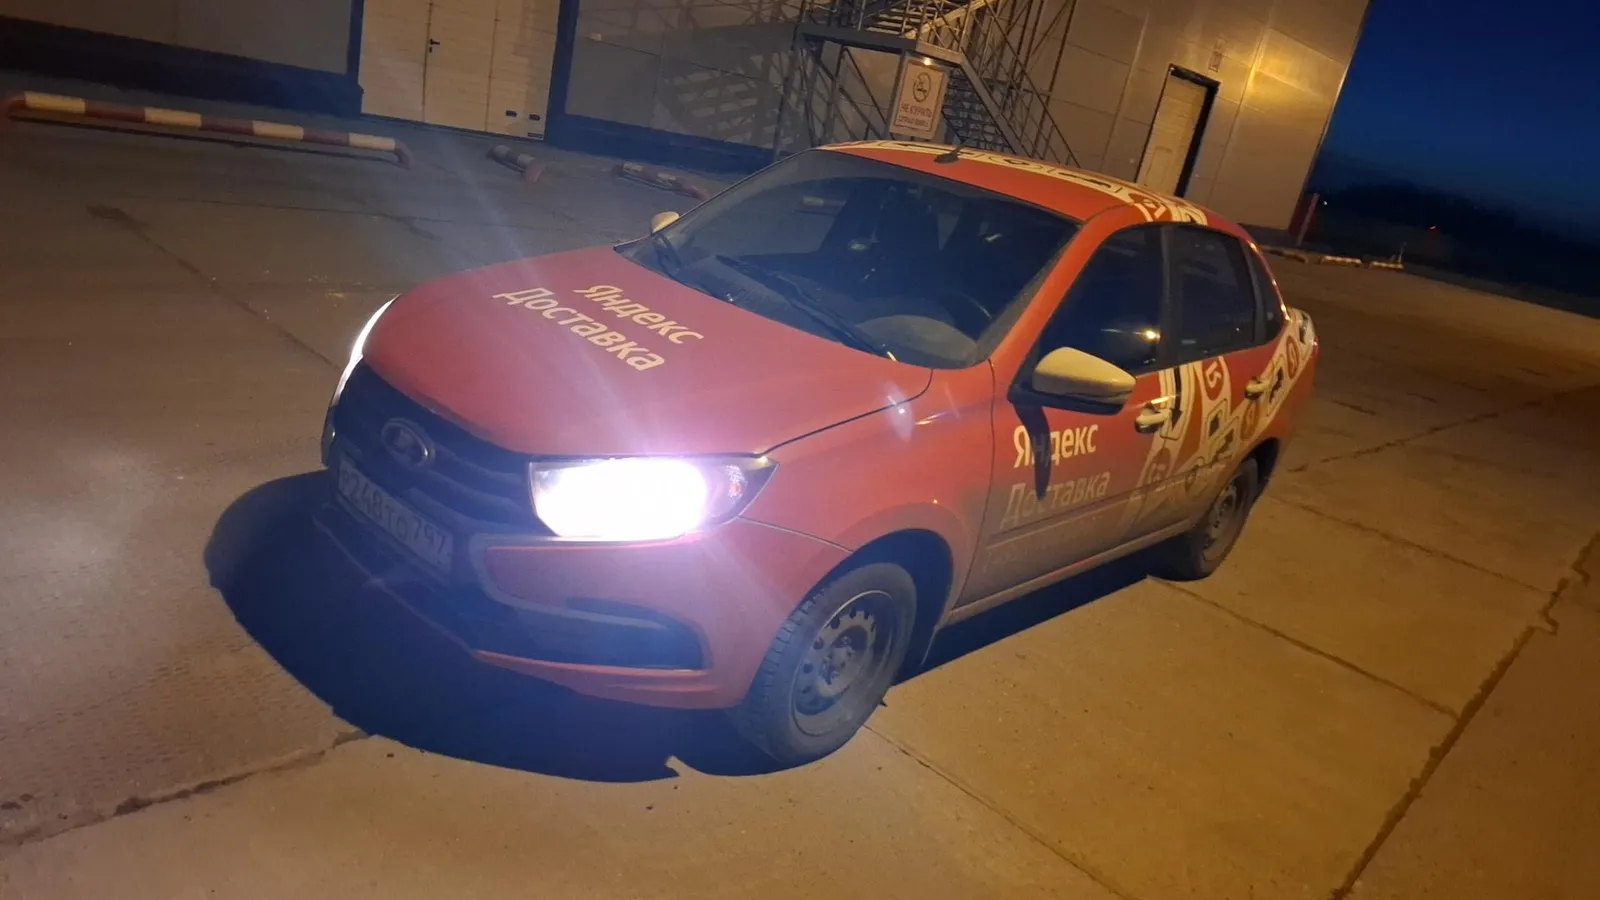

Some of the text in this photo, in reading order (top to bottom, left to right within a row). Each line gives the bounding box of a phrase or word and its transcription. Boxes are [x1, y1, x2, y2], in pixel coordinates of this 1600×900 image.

[492, 287, 665, 371] Доставка
[572, 285, 704, 344] Яндекс
[1013, 424, 1099, 468] Яндекс
[999, 471, 1111, 530] Доставка
